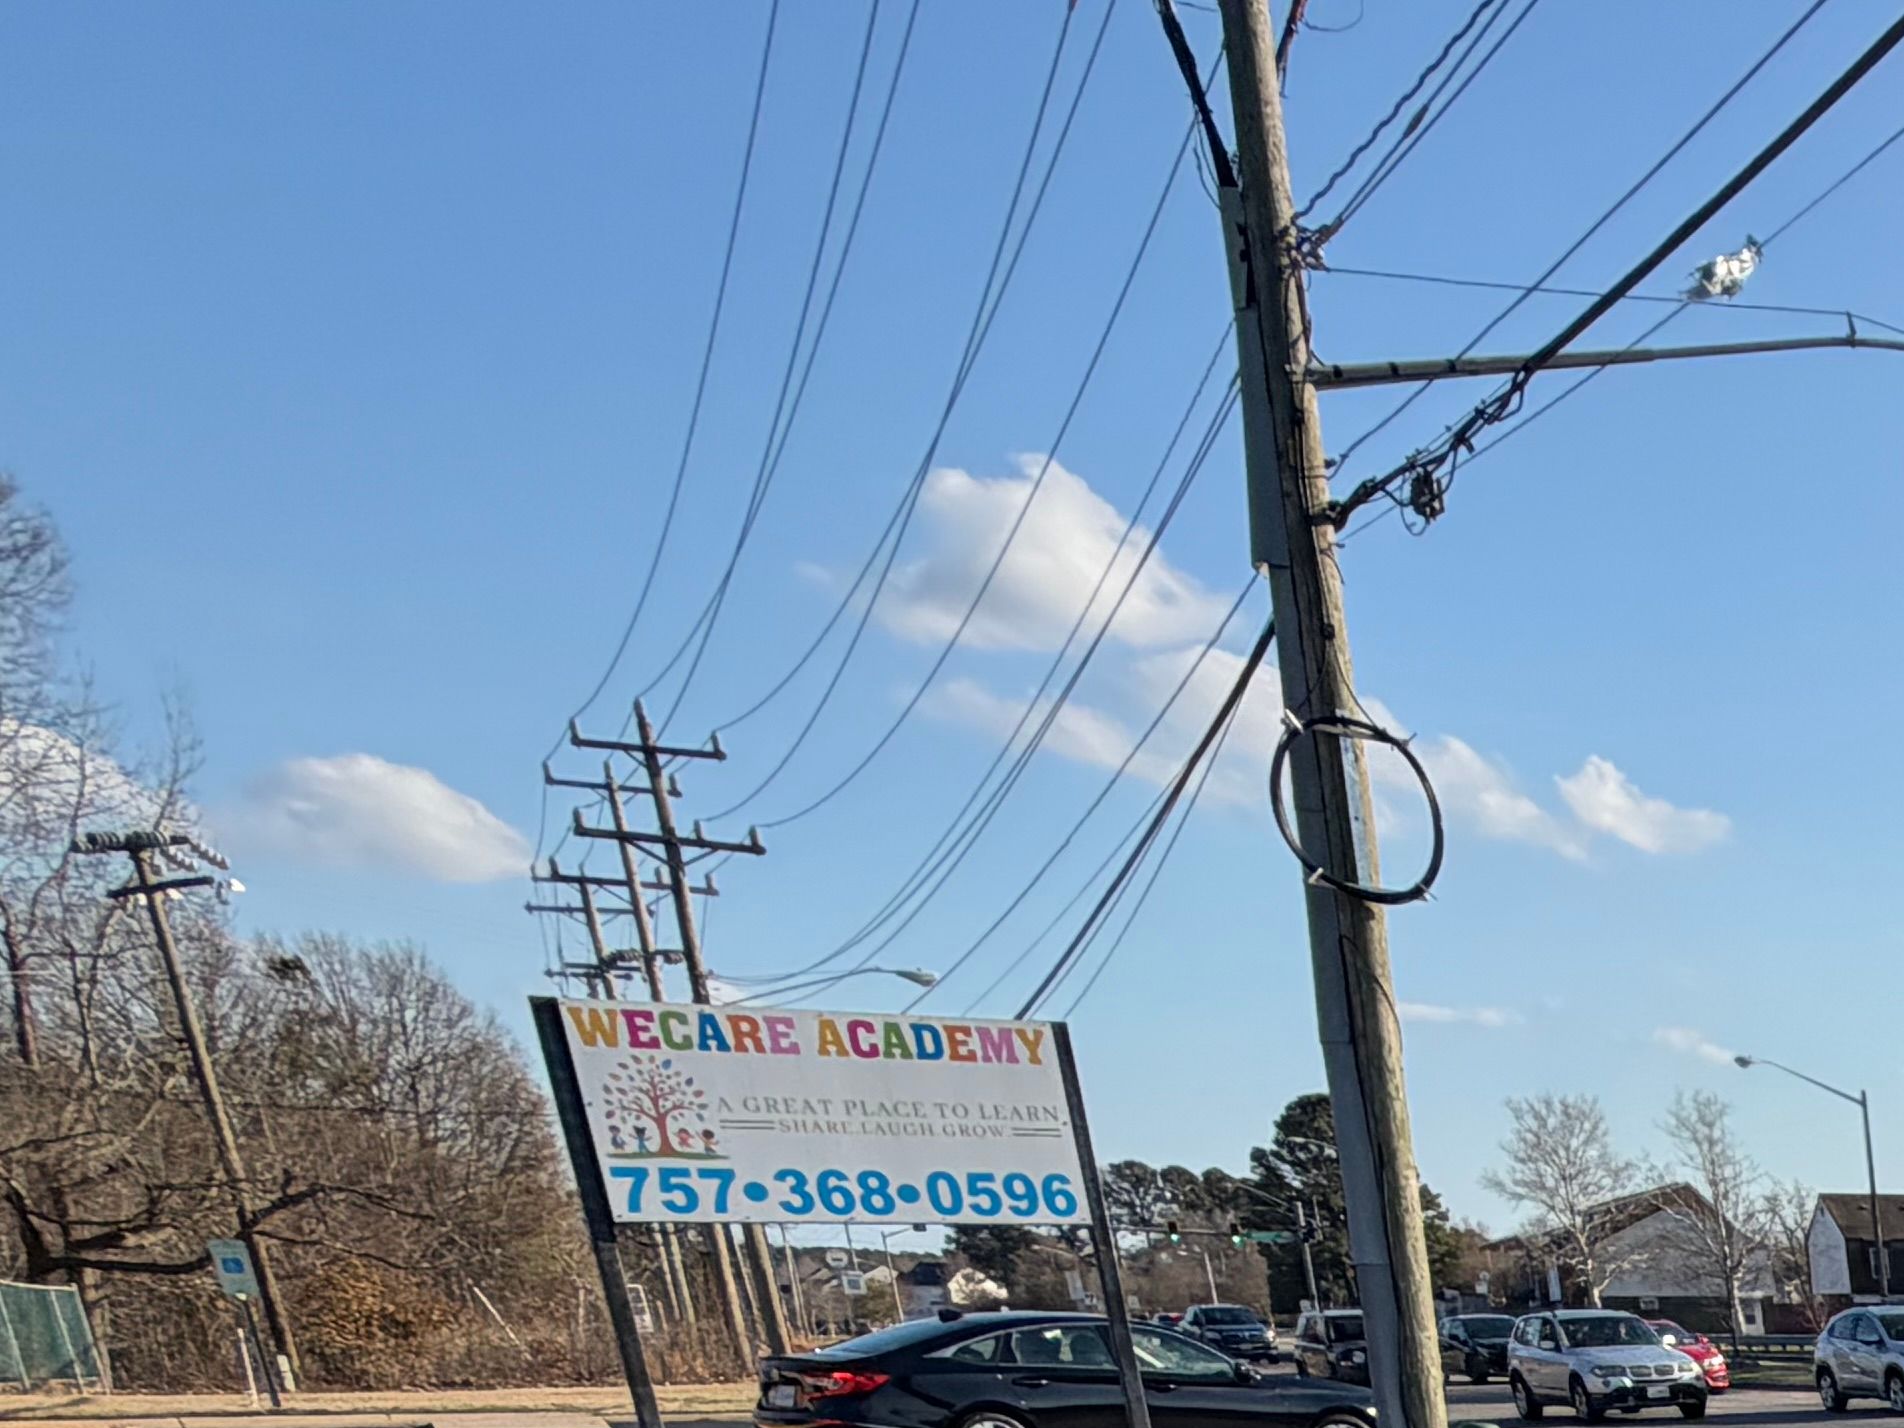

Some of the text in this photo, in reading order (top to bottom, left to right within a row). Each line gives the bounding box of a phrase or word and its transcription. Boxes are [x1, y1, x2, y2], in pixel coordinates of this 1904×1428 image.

[567, 1006, 1044, 1065] WECARE ACADEMY
[717, 1096, 1060, 1122] A GREAT PLACE TO LEARN
